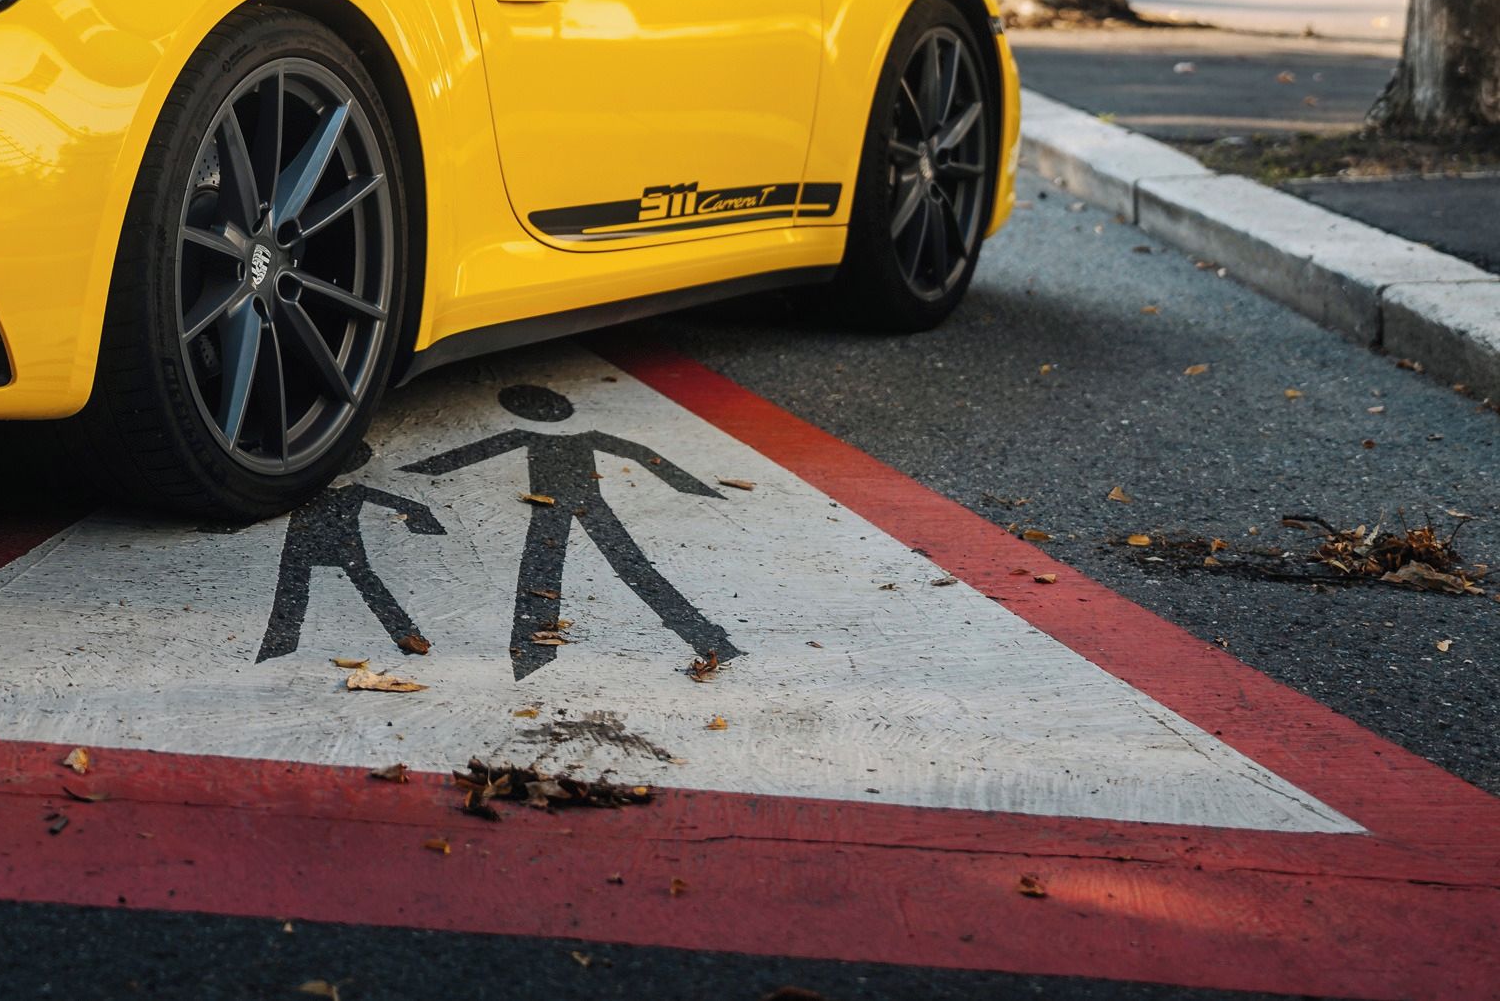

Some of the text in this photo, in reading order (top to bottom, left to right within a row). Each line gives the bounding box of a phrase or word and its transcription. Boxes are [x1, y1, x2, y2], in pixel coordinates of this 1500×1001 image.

[638, 181, 777, 222] 911 Carrera T
